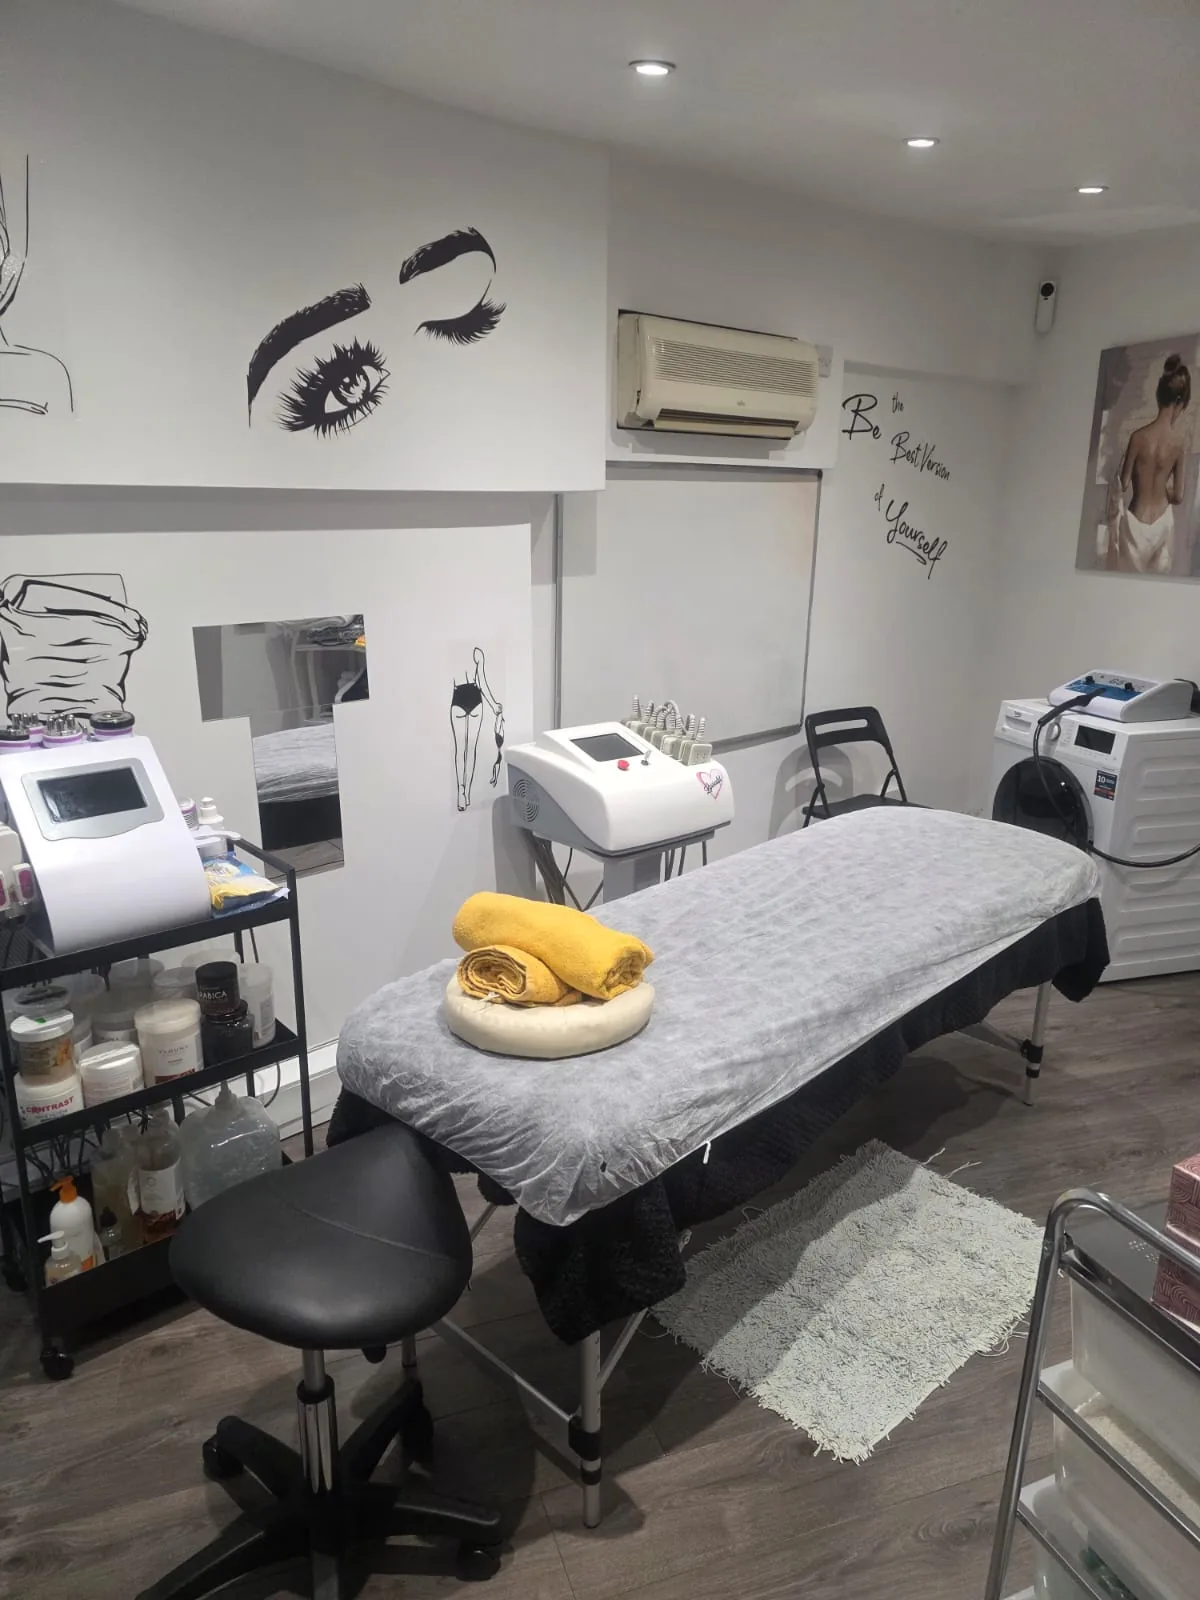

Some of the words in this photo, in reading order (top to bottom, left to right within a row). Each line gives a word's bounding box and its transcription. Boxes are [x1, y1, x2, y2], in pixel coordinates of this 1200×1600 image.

[842, 393, 882, 440] Be
[892, 392, 904, 414] the
[874, 483, 885, 512] of
[886, 499, 948, 580] Yourself
